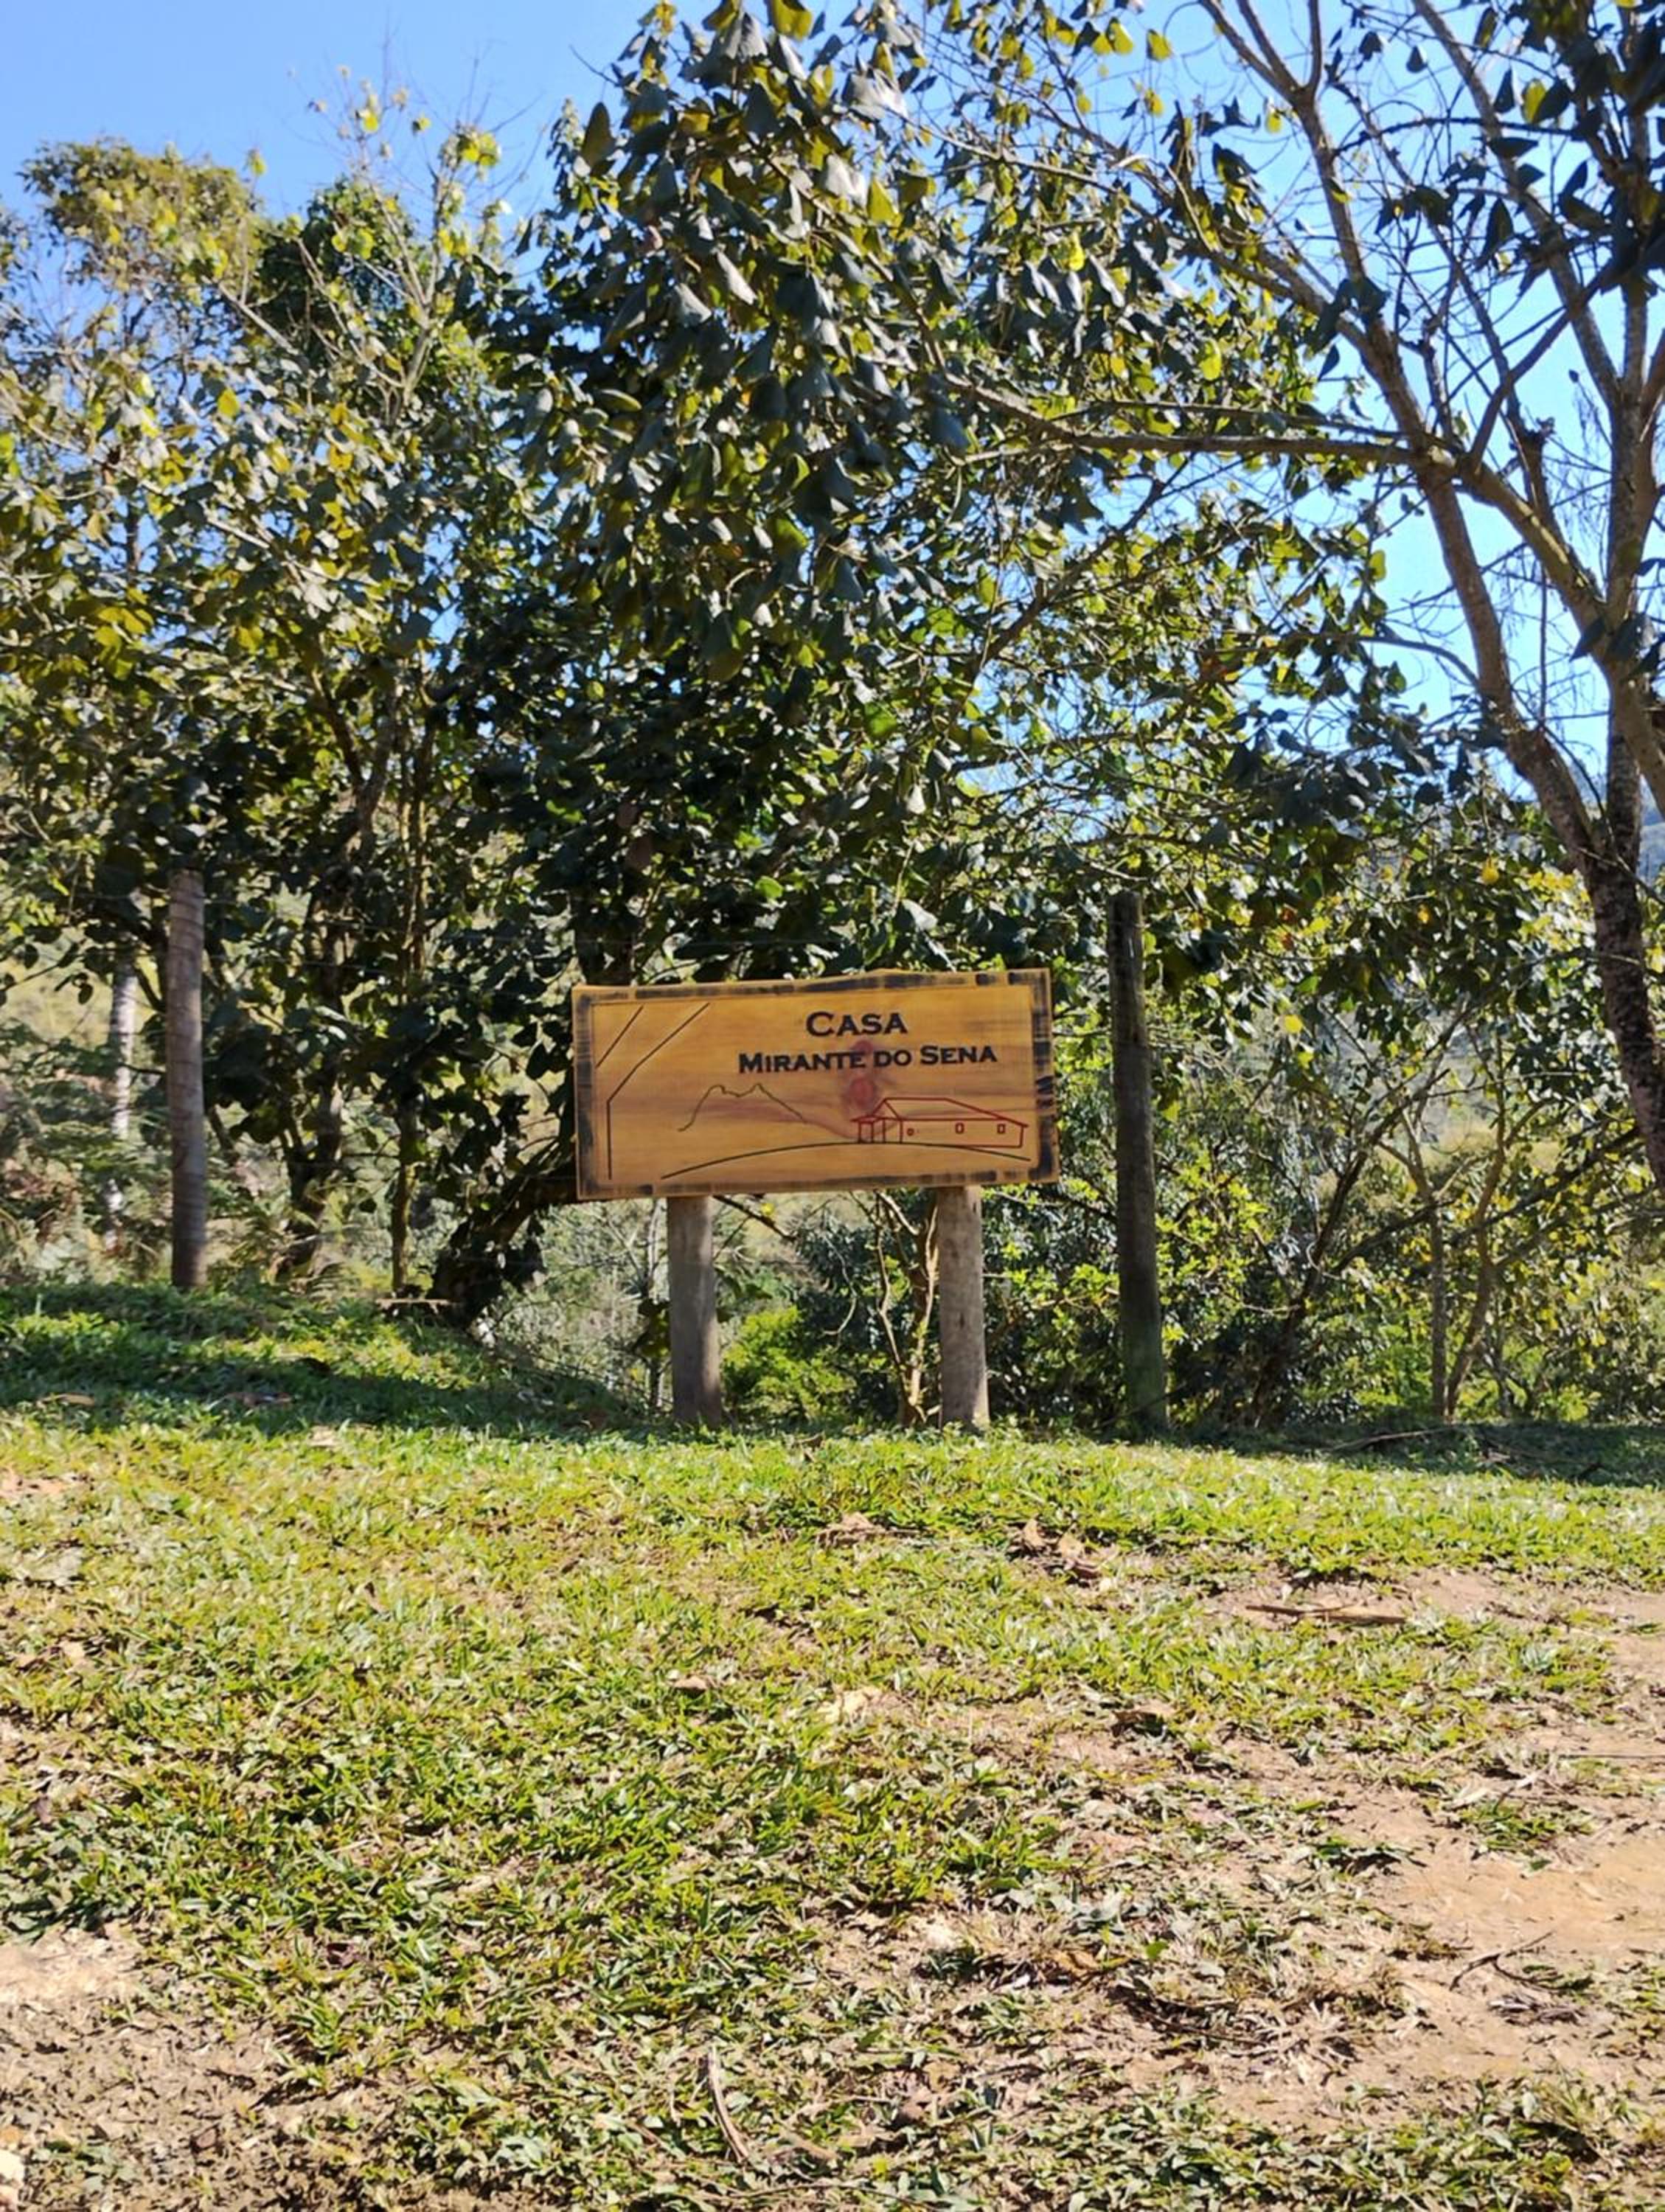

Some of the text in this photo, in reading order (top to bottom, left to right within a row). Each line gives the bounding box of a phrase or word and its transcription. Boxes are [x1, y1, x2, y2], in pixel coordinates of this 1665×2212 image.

[806, 1011, 908, 1037] CASA
[738, 1045, 998, 1074] MIRANTE DO SENA
